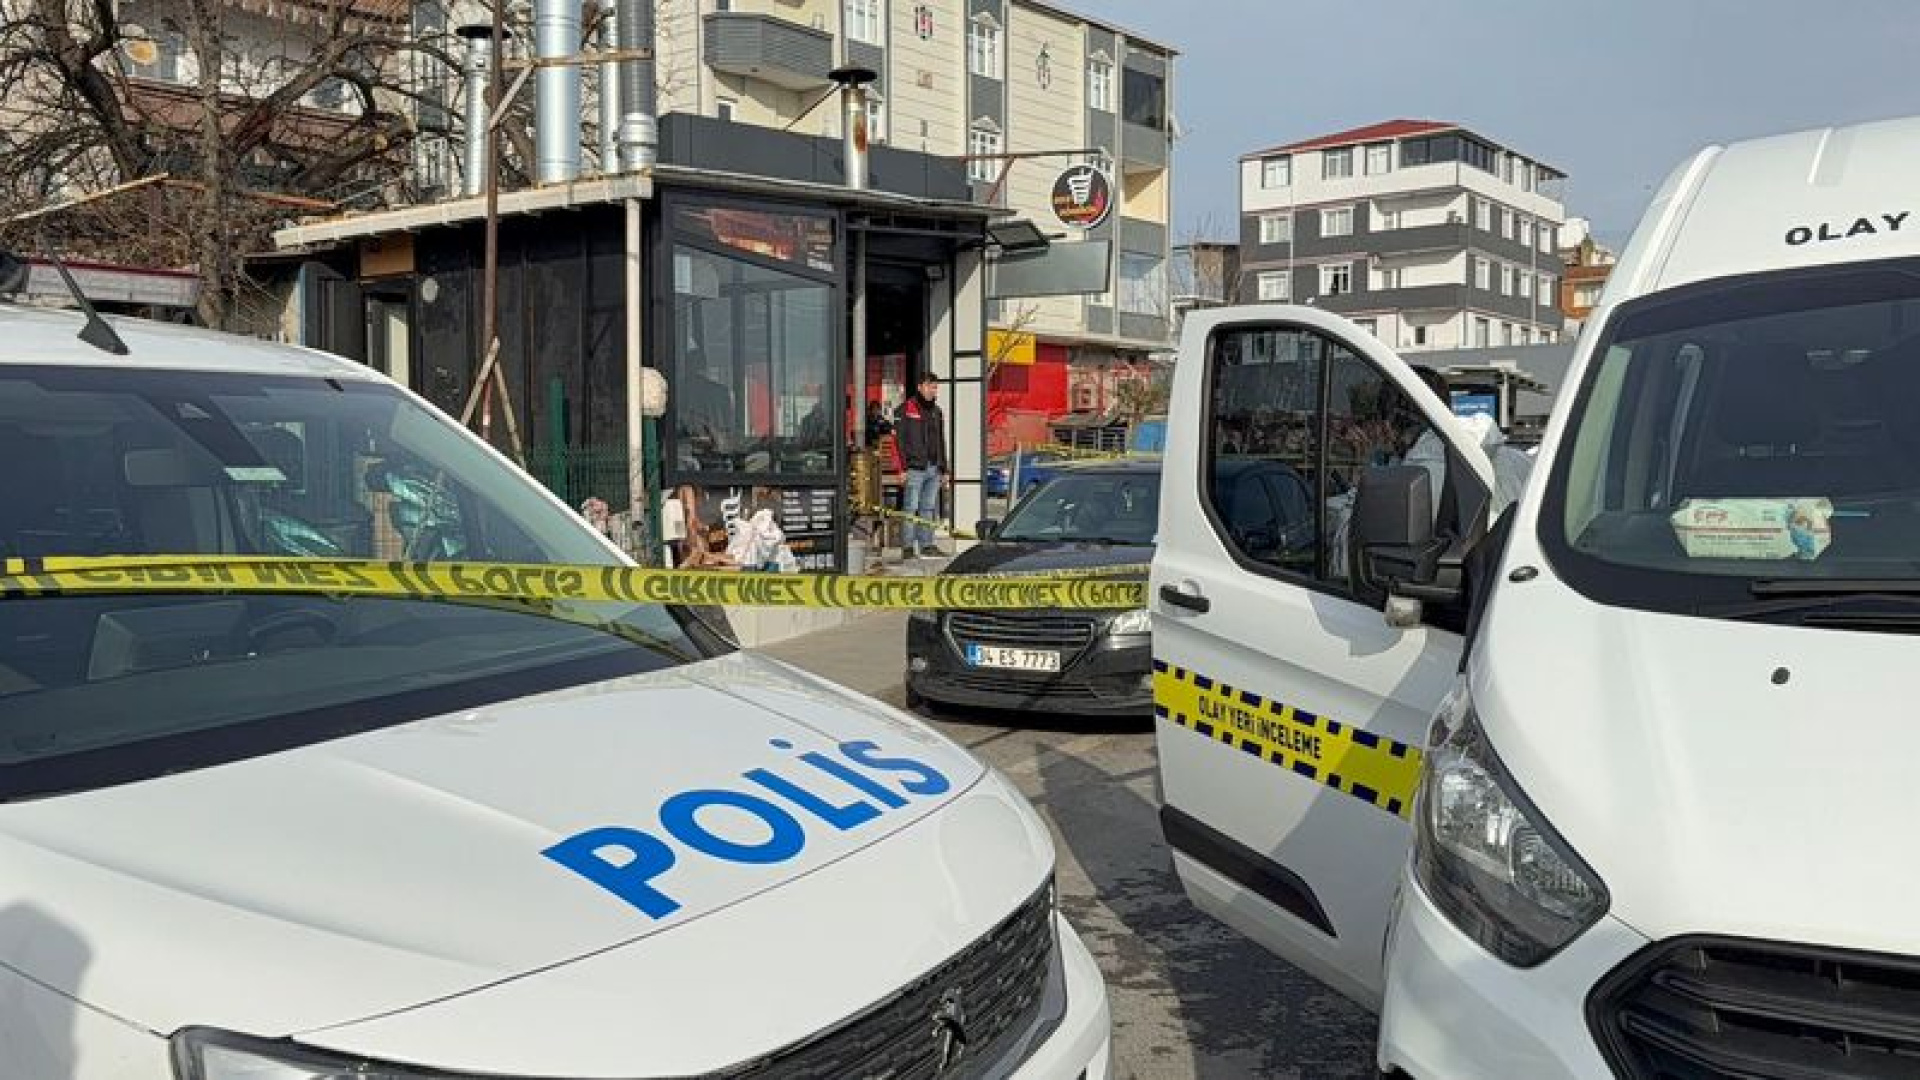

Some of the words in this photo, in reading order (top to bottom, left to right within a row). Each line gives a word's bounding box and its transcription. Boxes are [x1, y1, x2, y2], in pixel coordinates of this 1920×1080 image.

[1785, 211, 1911, 246] OLAY
[999, 649, 1017, 666] ES
[1198, 695, 1226, 722] OLAY
[1228, 708, 1255, 735] YERİ
[539, 738, 950, 920] POLİS
